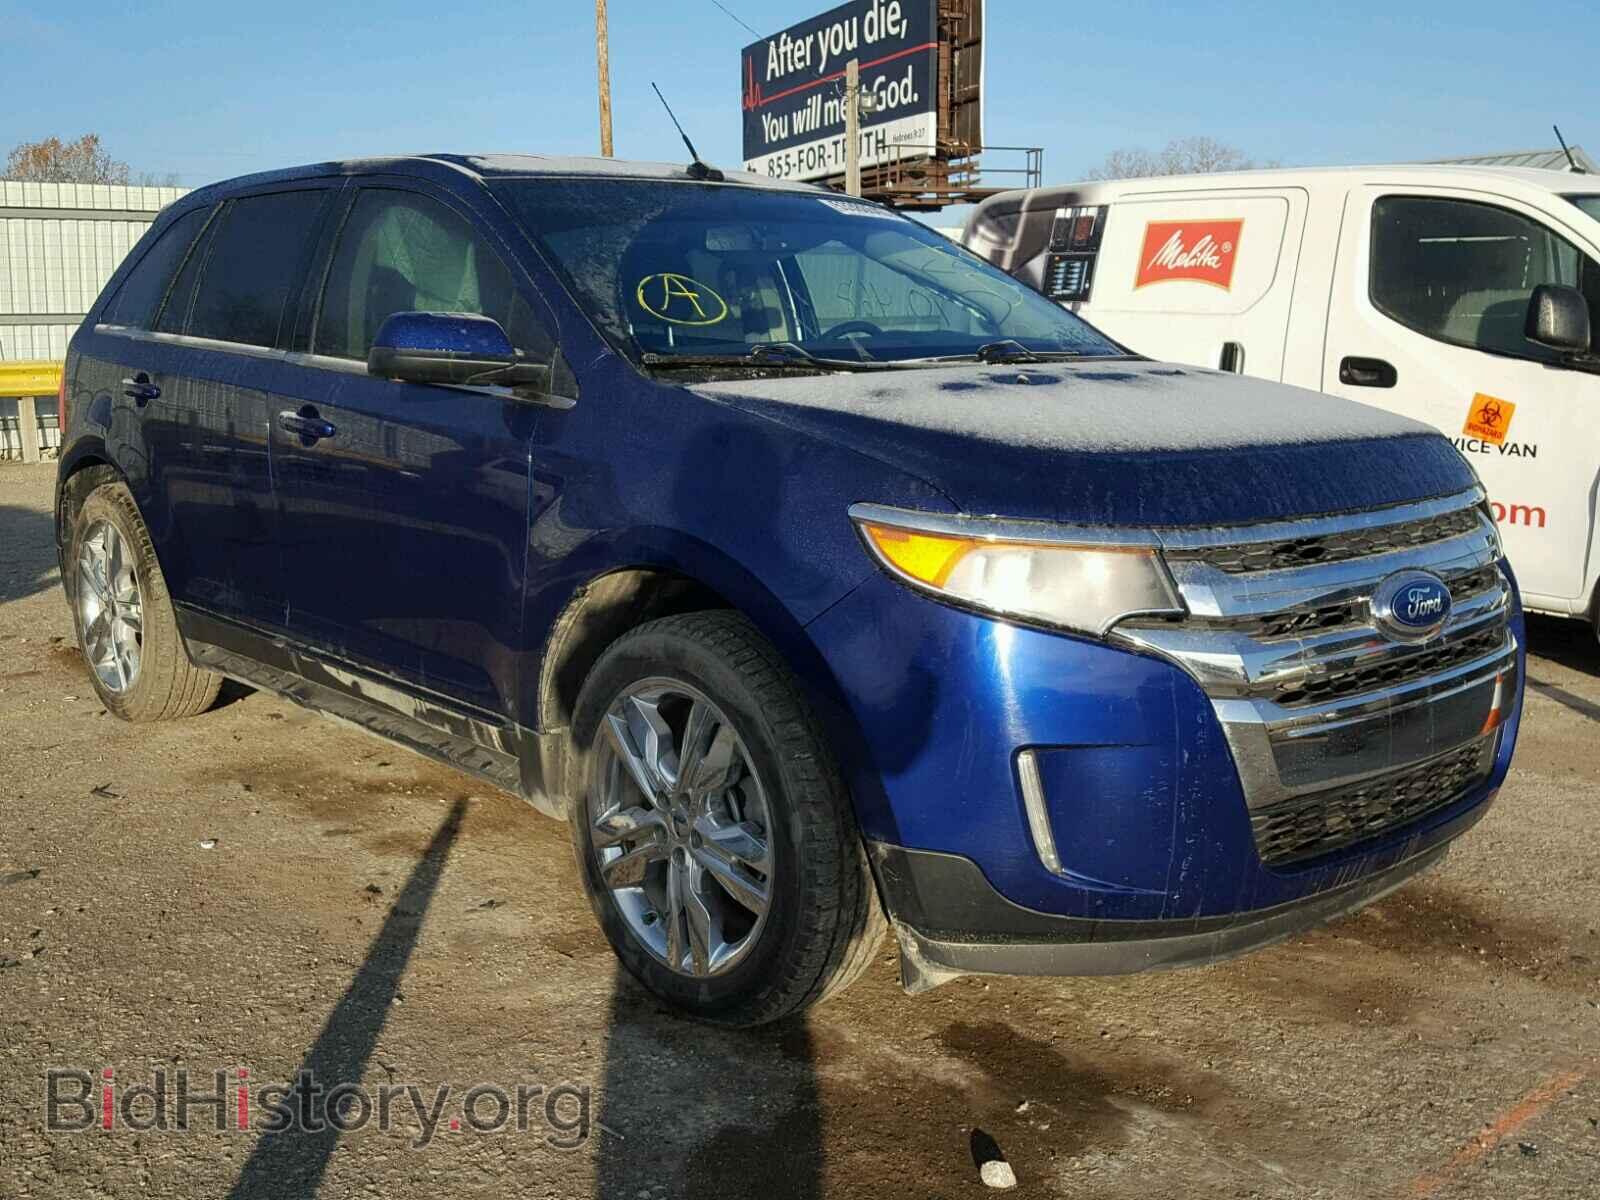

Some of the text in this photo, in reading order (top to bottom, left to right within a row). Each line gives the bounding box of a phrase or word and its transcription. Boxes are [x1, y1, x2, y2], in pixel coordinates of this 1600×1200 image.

[766, 0, 908, 81] After you die,
[761, 65, 919, 144] You will me God.
[1450, 437, 1538, 458] VICE VAN
[1490, 502, 1546, 528] om
[1407, 586, 1442, 618] Ford
